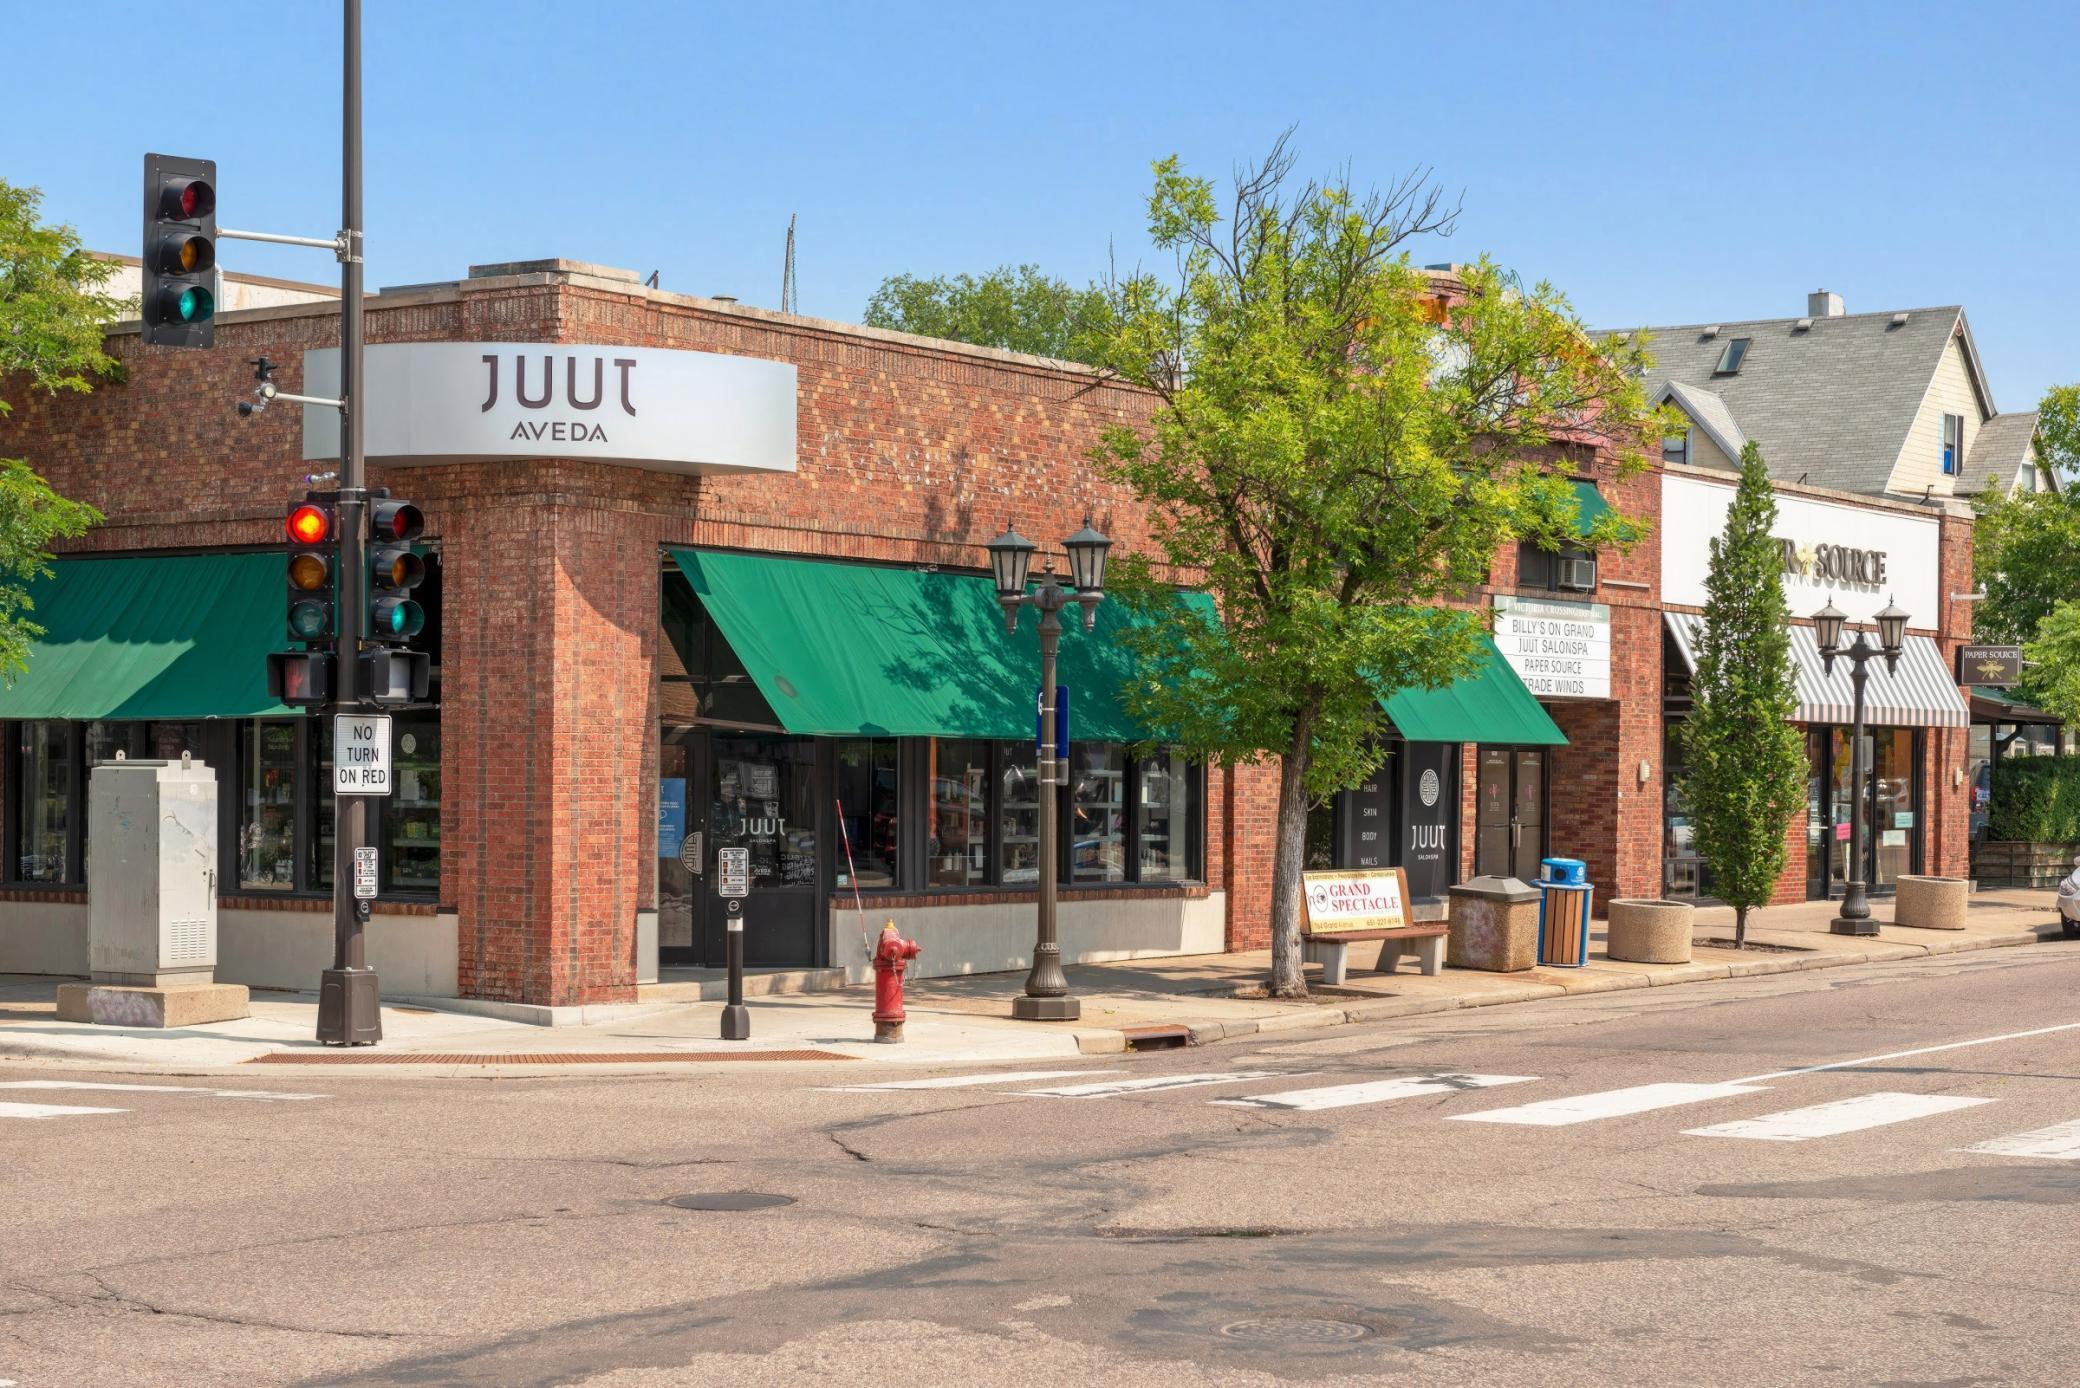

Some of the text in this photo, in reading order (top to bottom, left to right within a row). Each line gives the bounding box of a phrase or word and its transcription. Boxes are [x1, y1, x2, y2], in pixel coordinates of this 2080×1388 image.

[482, 355, 637, 417] JUUT
[510, 421, 608, 442] AVEDA
[1814, 543, 1887, 585] SOURCE
[1512, 619, 1595, 638] BILLY'S ON GRAND
[1518, 638, 1589, 655] JUUT SALONSPA
[1965, 650, 2018, 659] PAPER SOURCE
[1524, 658, 1582, 674] PAPER SOURCE
[1555, 679, 1585, 694] WINDS
[353, 726, 373, 740] NO
[347, 747, 379, 762] TURN
[340, 769, 386, 784] ON RED
[1363, 784, 1378, 793] HAIR
[1363, 808, 1377, 817] SKIN
[740, 818, 786, 836] JUUT
[1361, 832, 1377, 841] BODY
[1411, 825, 1446, 850] JUUT
[1360, 857, 1378, 866] NAILS
[1329, 883, 1371, 897] GRAND
[1331, 896, 1399, 912] SPECTACLE
